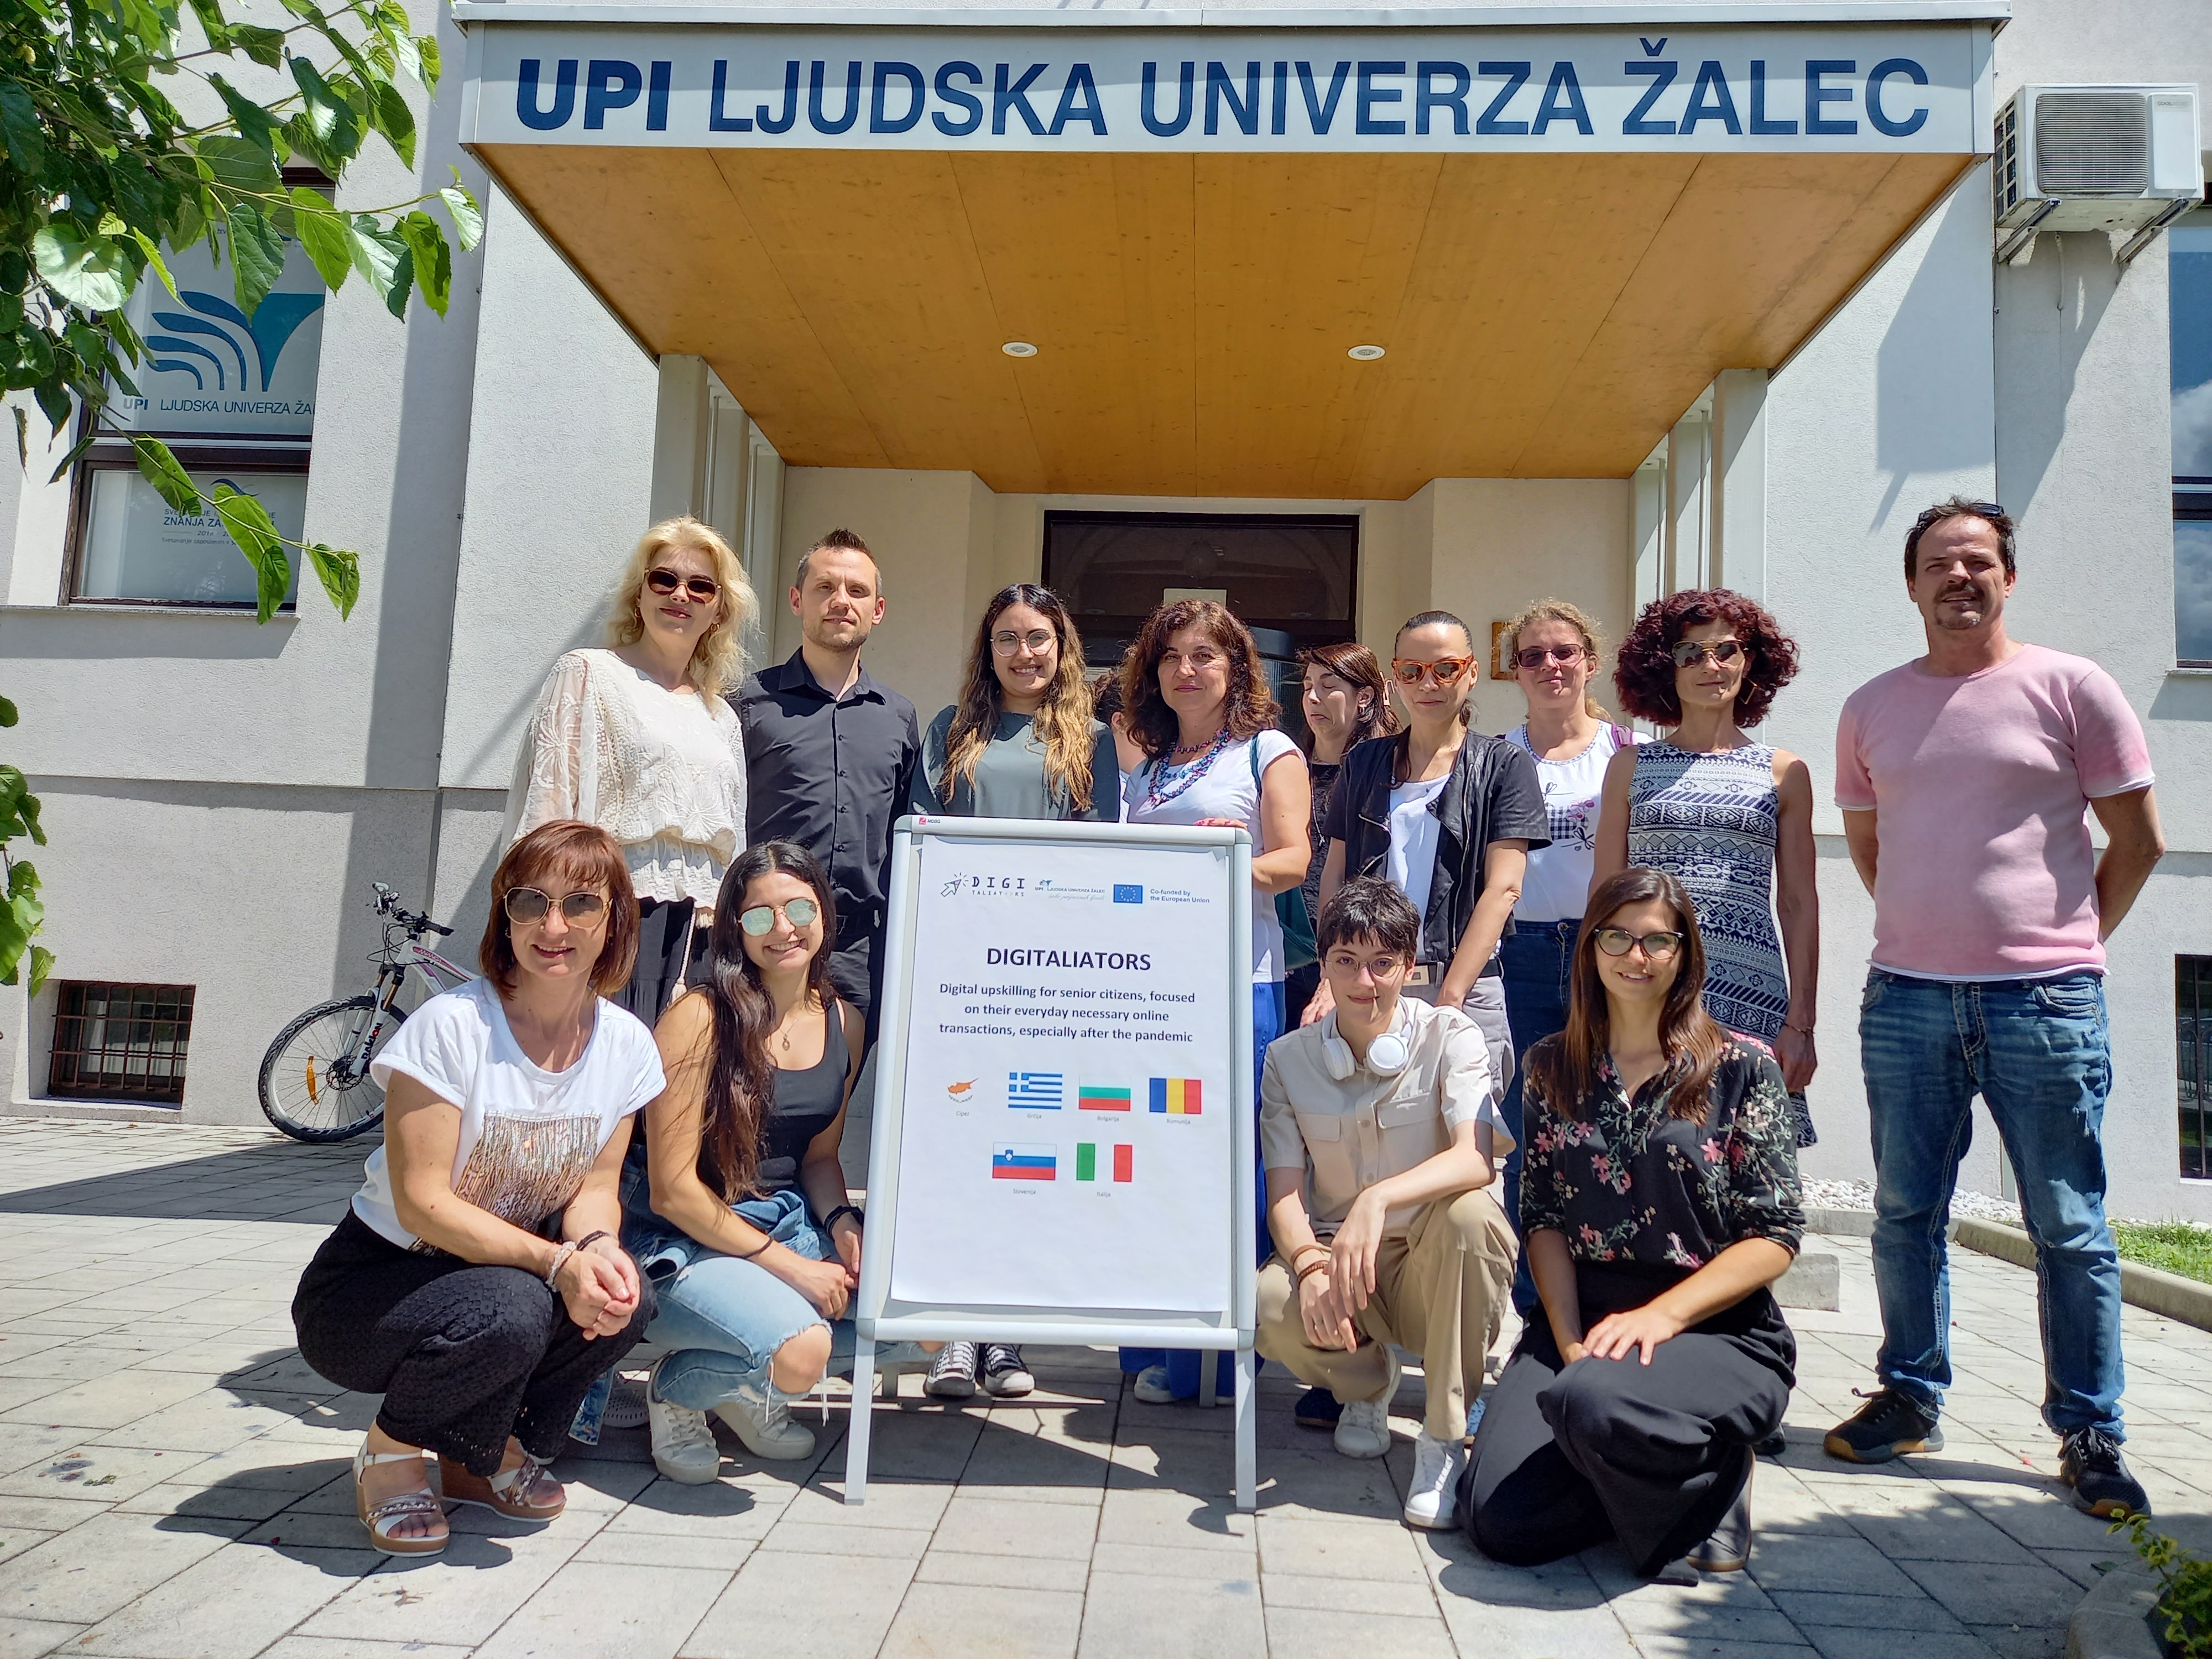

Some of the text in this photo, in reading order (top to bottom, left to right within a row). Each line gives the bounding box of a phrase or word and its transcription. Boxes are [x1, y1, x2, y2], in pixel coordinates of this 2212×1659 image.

[517, 38, 1929, 137] UPI LJUDSKA UNIVERZA ŽALEC
[123, 398, 148, 410] UPI
[160, 399, 219, 412] LJUDSKA
[224, 401, 290, 414] UNIVERZA
[163, 517, 204, 526] ZNANJA
[972, 877, 1025, 889] DIGI
[987, 948, 1151, 971] DIGITALIATORS
[940, 983, 1195, 1003] Digital upskilling for senior citizens, focused
[964, 1004, 1170, 1022] on their everyday necessary online
[940, 1023, 1193, 1042] transactions, especially after the pandemic
